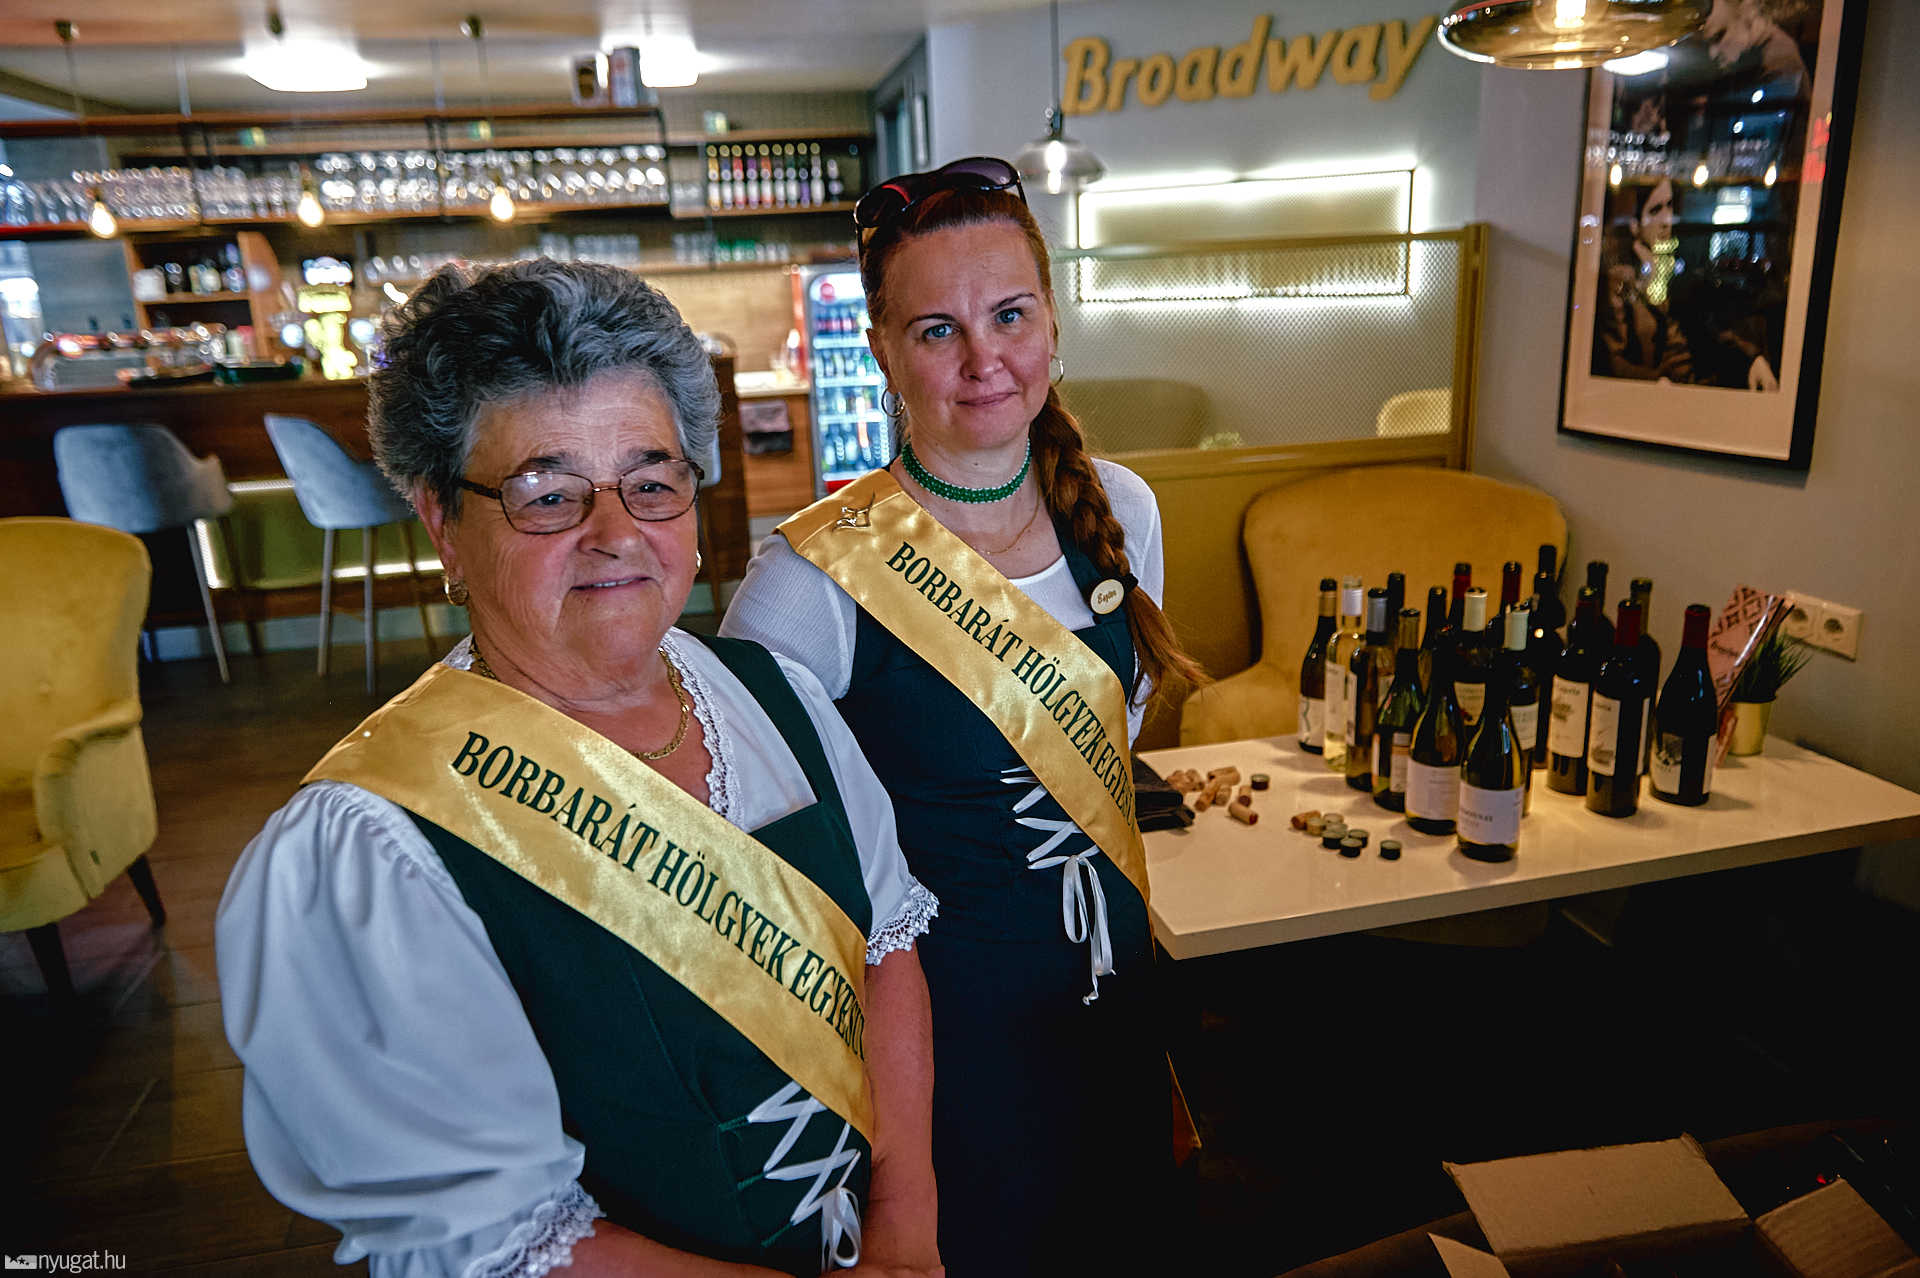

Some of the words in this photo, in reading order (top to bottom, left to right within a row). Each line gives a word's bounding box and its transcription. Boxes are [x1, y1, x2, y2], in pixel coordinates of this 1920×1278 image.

[1061, 13, 1439, 116] Broadway
[886, 541, 1022, 662] BORBARÁT
[1011, 646, 1106, 765] HÖLGYEK
[451, 731, 659, 873] BORBARÁT
[647, 840, 801, 986] HÖLGYEK
